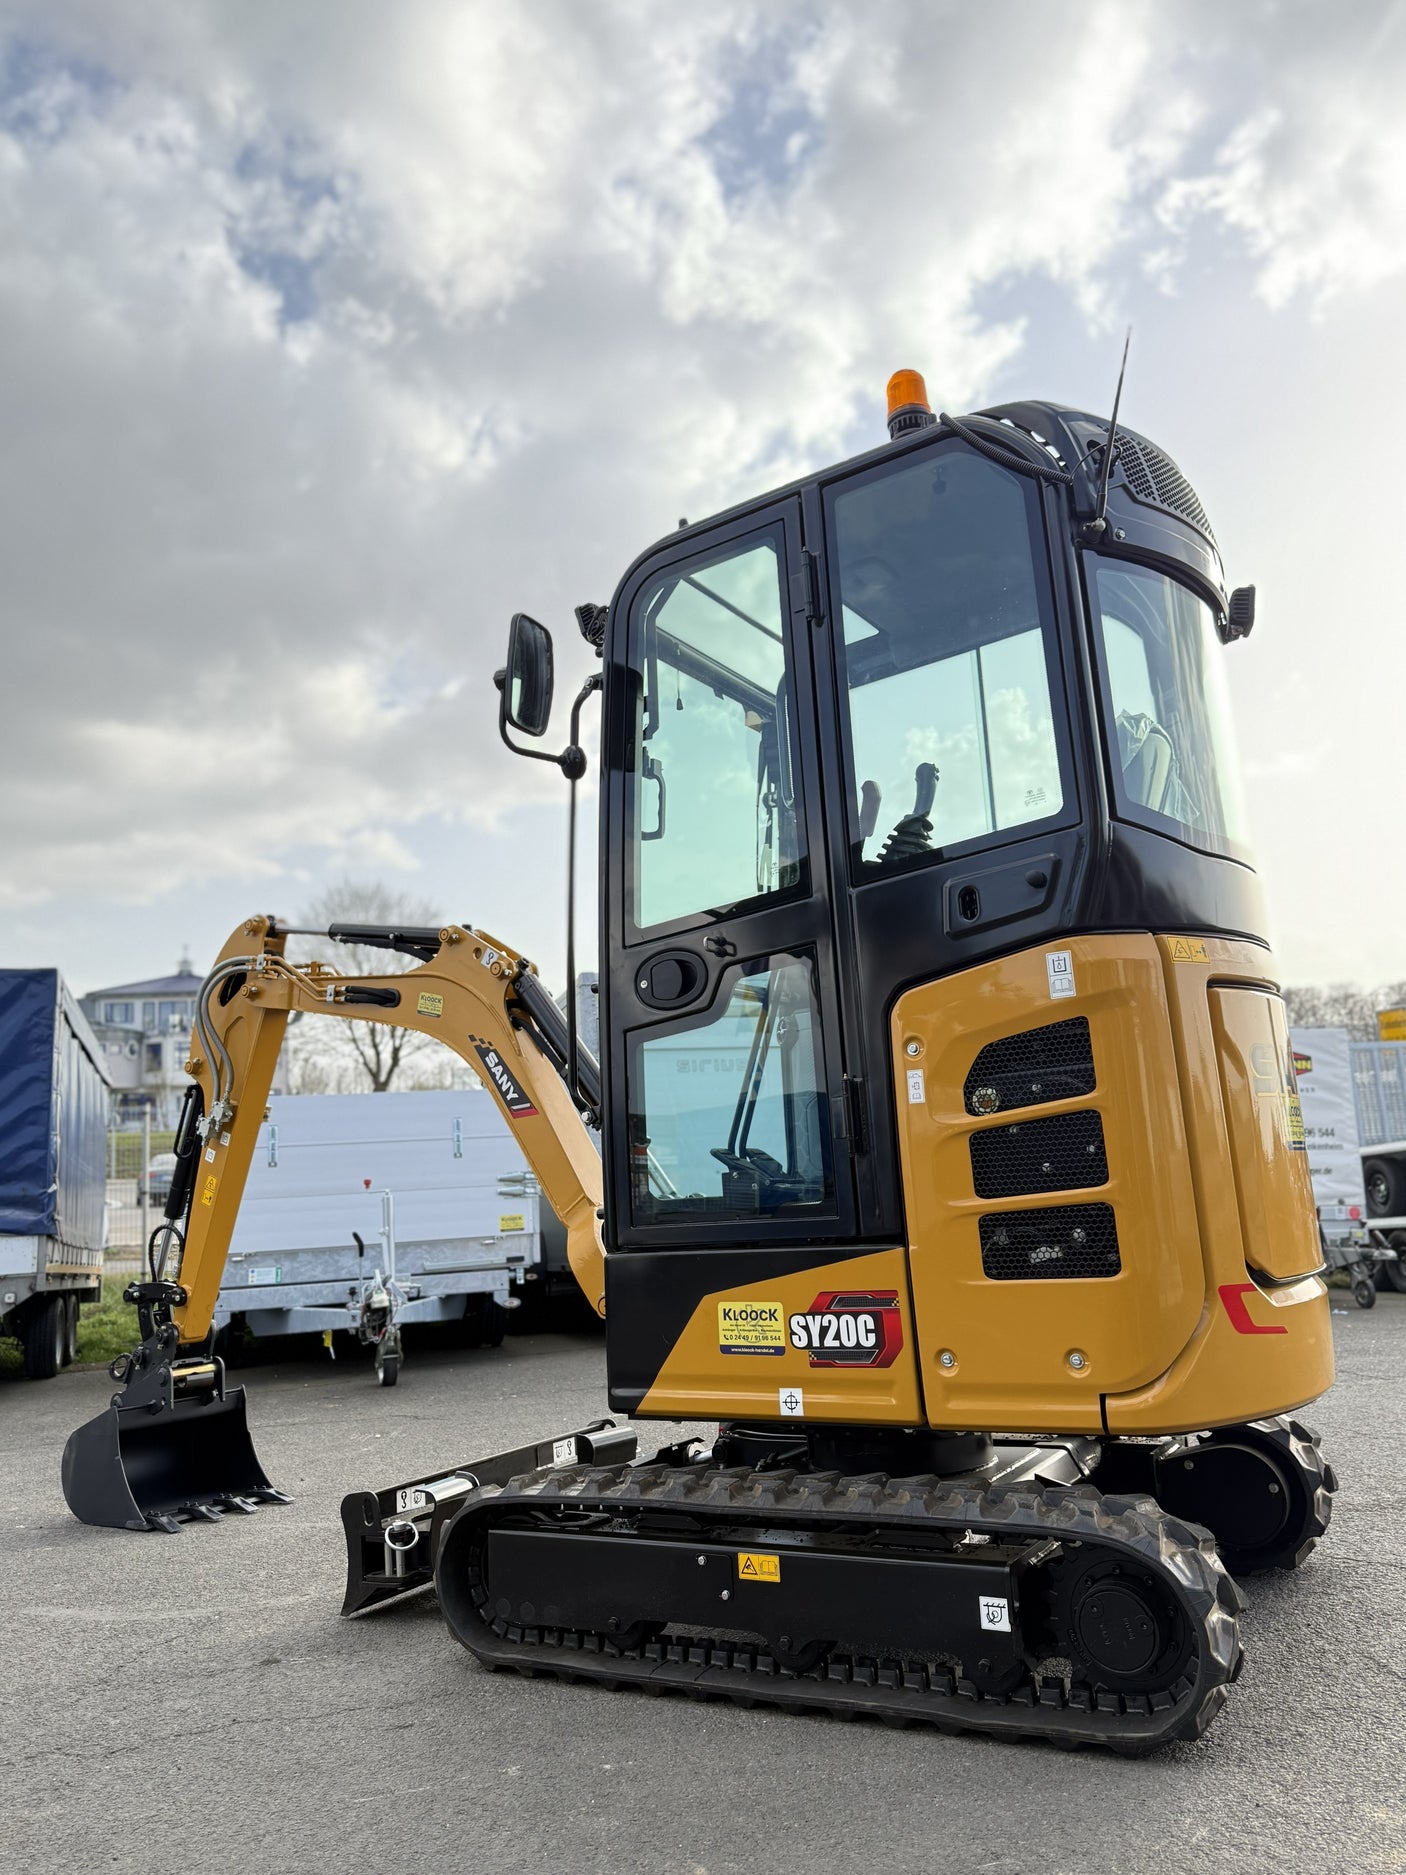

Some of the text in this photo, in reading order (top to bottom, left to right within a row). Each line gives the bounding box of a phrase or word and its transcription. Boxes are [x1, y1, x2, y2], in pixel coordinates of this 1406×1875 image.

[485, 1051, 519, 1101] SANY
[1318, 1127, 1335, 1138] 544
[723, 1308, 779, 1322] KLOOCK
[790, 1314, 876, 1348] SY20C
